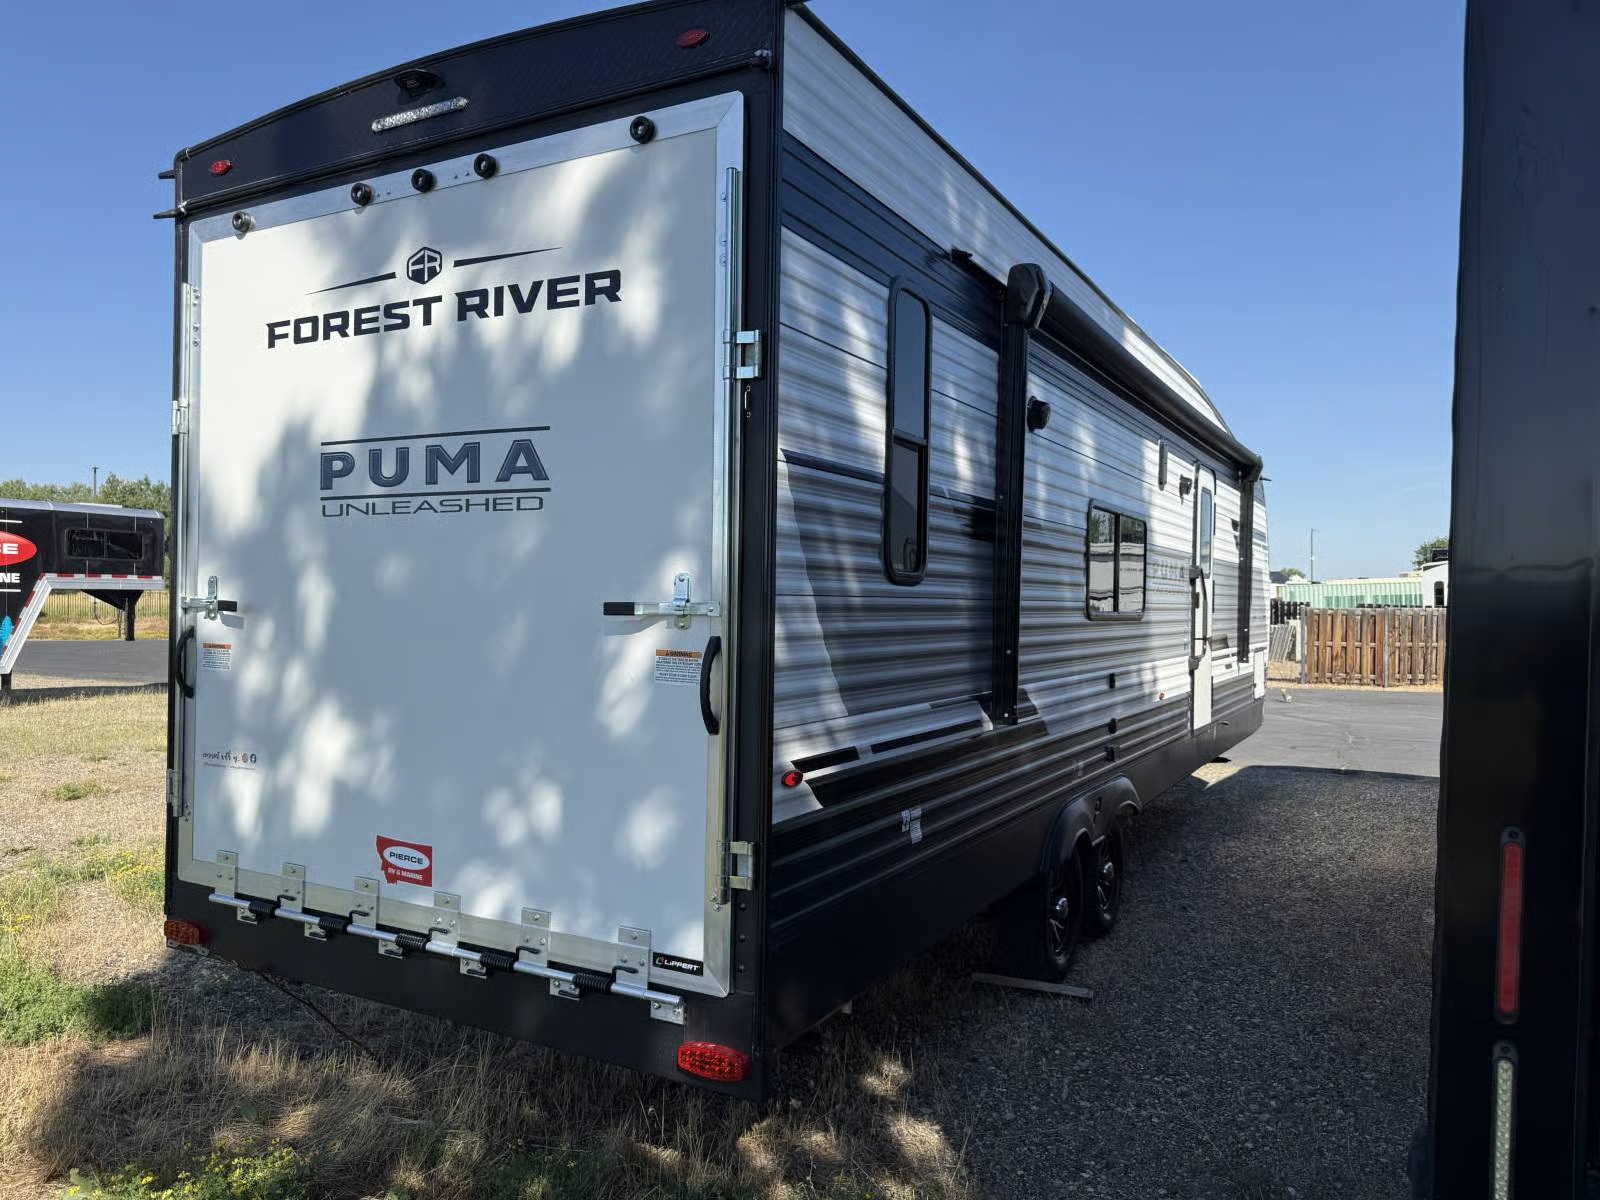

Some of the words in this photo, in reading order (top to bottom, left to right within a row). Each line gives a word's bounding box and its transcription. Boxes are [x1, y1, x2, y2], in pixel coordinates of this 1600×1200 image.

[266, 295, 442, 349] FOREST
[454, 269, 622, 322] RIVER
[320, 439, 550, 491] PUMA
[321, 496, 544, 517] UNLEASHED
[389, 851, 424, 865] PIERCE
[388, 867, 396, 875] RV
[401, 870, 423, 881] MARINE
